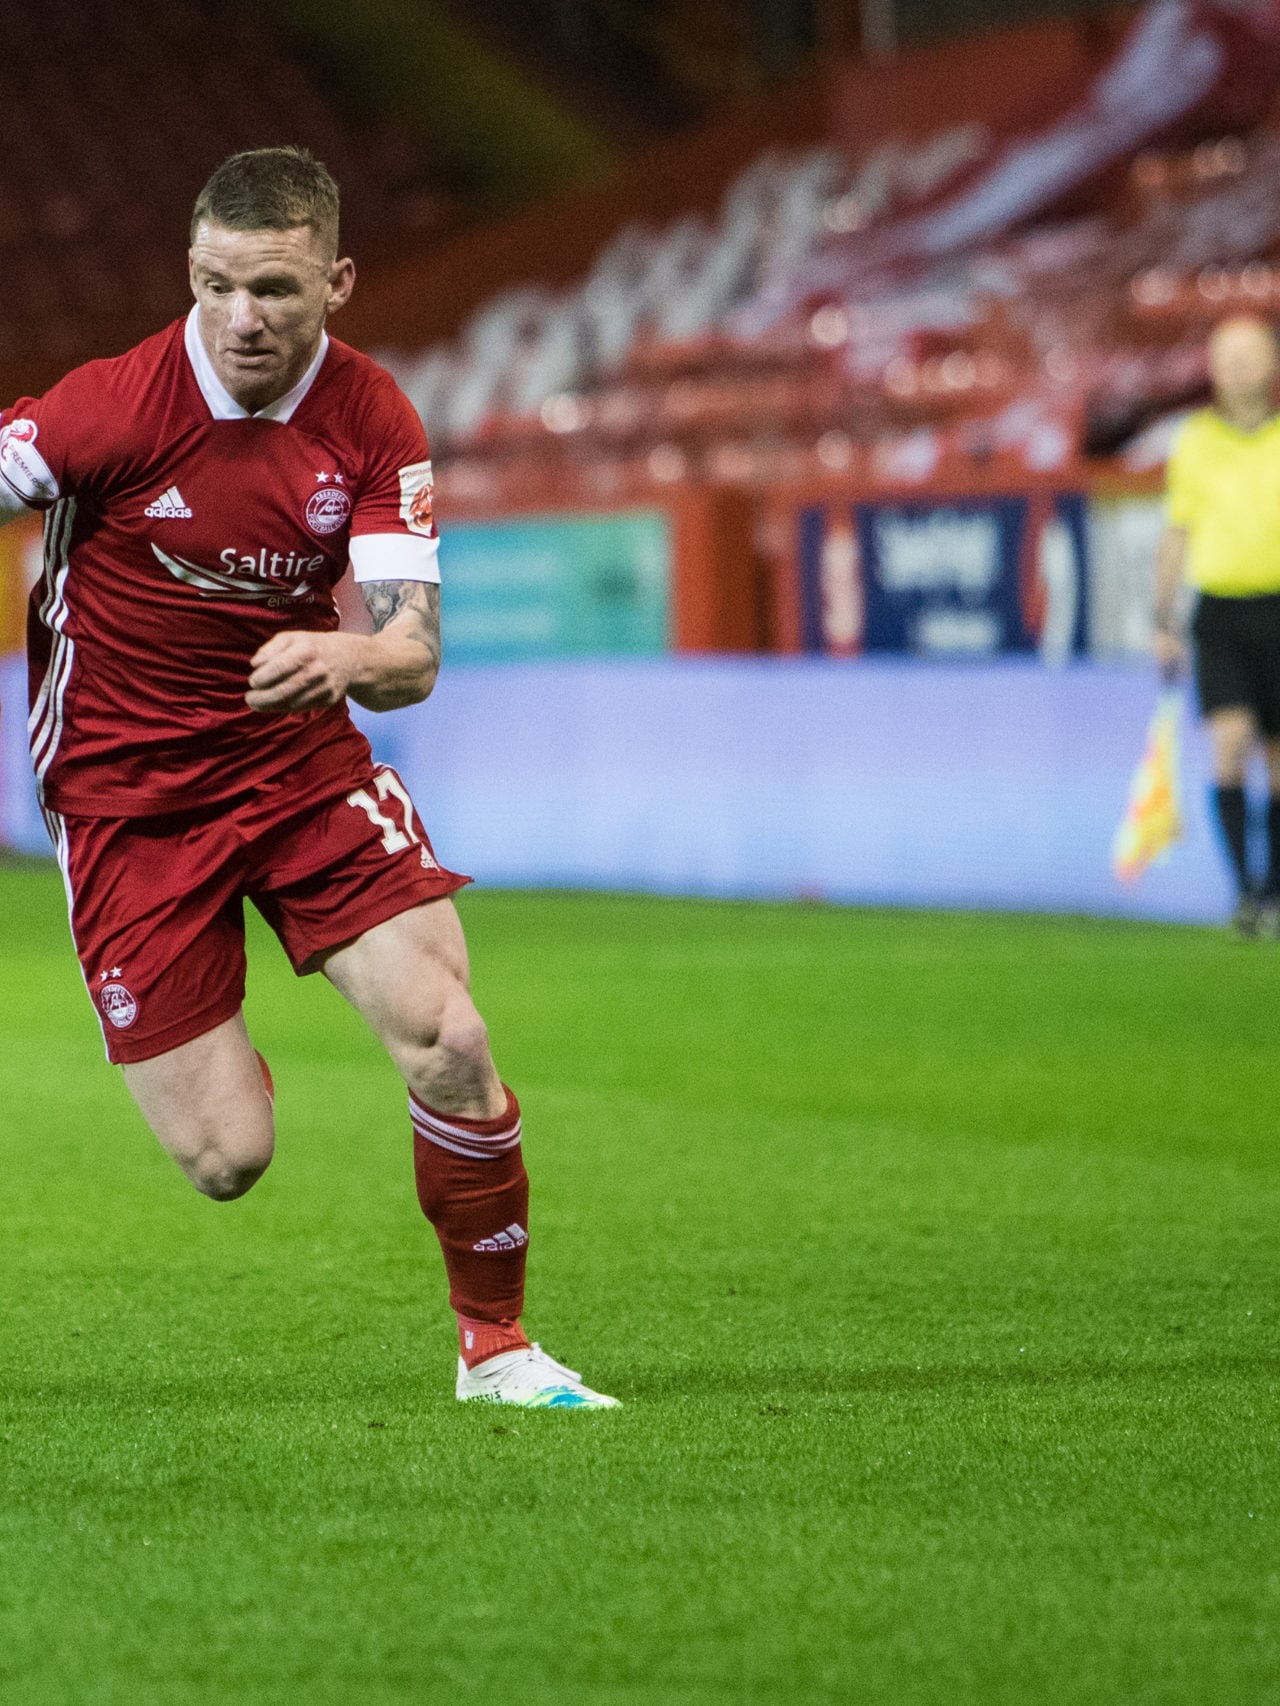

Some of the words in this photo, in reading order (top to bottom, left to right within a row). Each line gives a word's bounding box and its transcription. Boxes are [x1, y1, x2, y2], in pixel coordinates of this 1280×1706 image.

[144, 506, 193, 518] adidas
[219, 547, 325, 578] Saltire
[347, 769, 421, 855] 17
